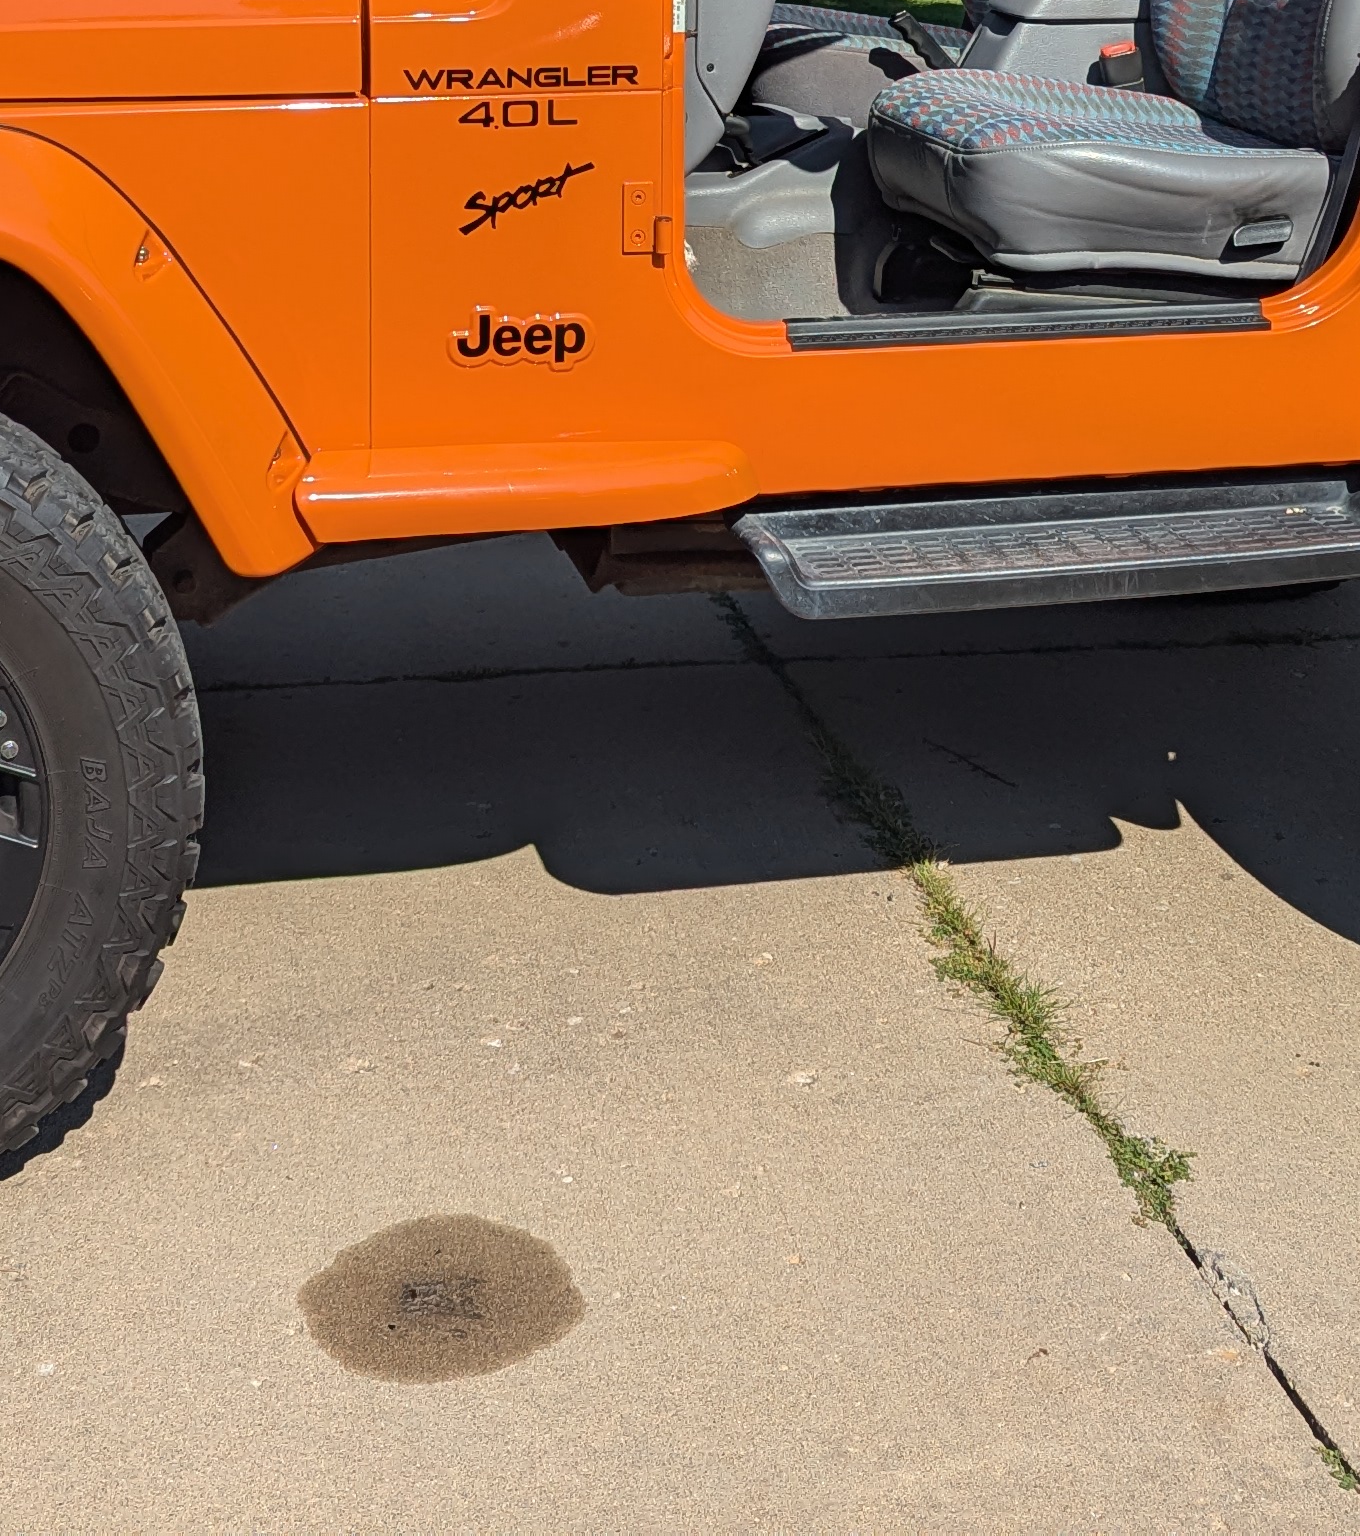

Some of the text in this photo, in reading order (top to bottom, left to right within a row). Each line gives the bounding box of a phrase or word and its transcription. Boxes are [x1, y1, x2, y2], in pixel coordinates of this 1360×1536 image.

[403, 65, 639, 91] WRANGLER
[456, 314, 586, 363] Jeep
[78, 756, 114, 871] BAJA
